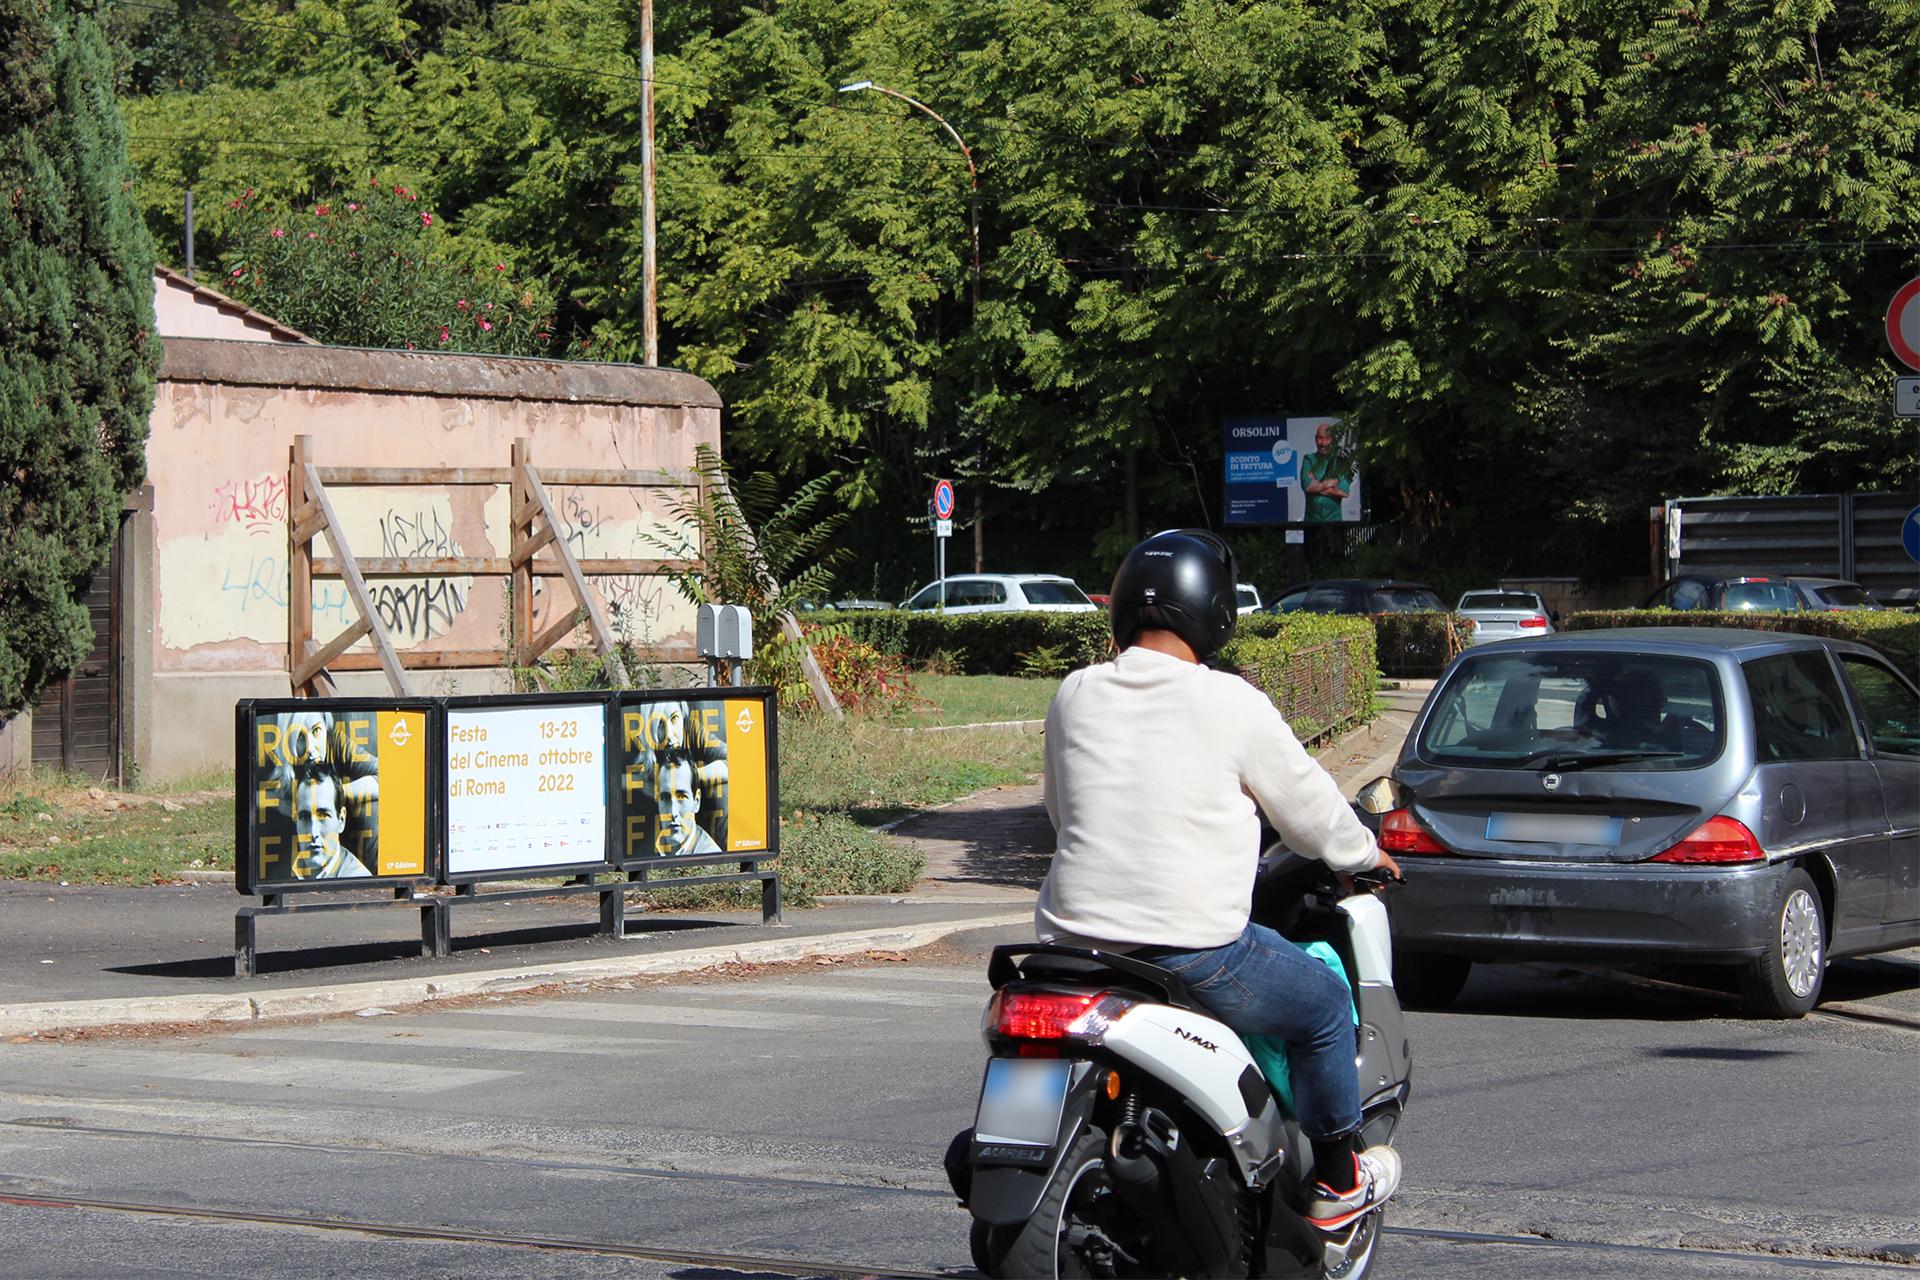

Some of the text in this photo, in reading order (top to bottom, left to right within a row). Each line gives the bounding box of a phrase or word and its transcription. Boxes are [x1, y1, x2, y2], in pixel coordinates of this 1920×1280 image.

[1232, 426, 1280, 438] ORSOLINI
[1230, 455, 1260, 464] SCONTO
[1230, 462, 1274, 471] IN FATTURA
[451, 725, 488, 743] Festa
[539, 720, 578, 739] 13-23
[623, 709, 721, 753] ROME
[257, 720, 370, 768] ROME
[450, 750, 529, 770] del Cinema
[538, 748, 593, 765] ottobre
[450, 778, 506, 797] di Roma
[538, 774, 574, 792] 2022
[625, 760, 723, 805] FILM
[258, 777, 372, 825] FILM
